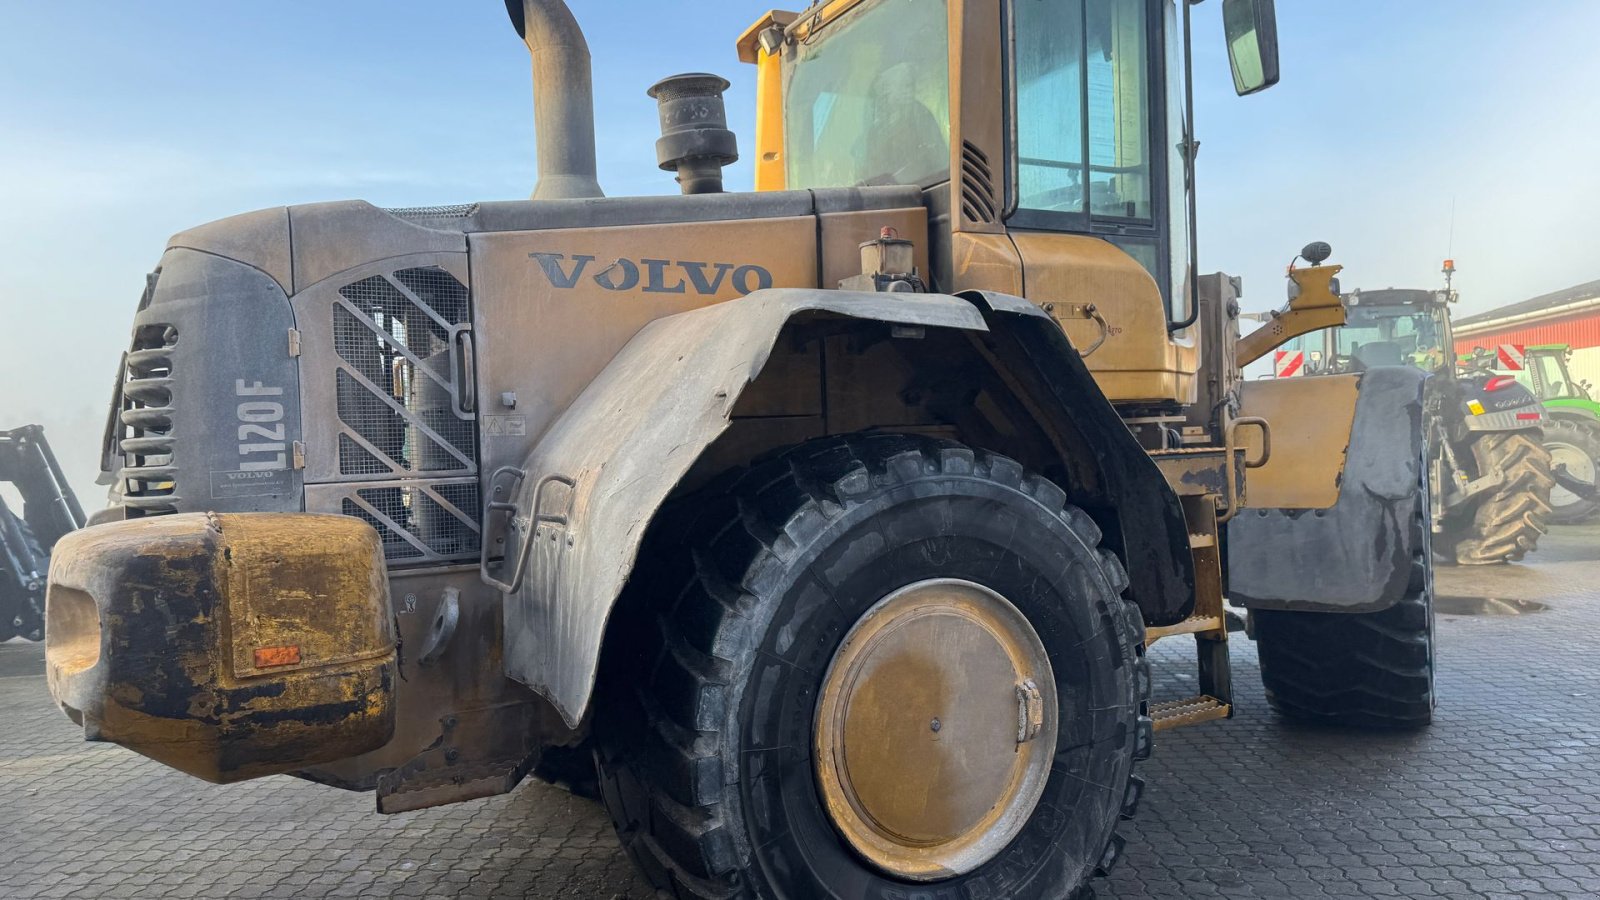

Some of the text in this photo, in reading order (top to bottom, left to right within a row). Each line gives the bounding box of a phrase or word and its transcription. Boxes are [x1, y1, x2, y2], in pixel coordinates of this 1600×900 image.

[528, 253, 773, 296] VOLVO
[236, 379, 286, 471] L120F
[226, 471, 274, 479] VOLVO
